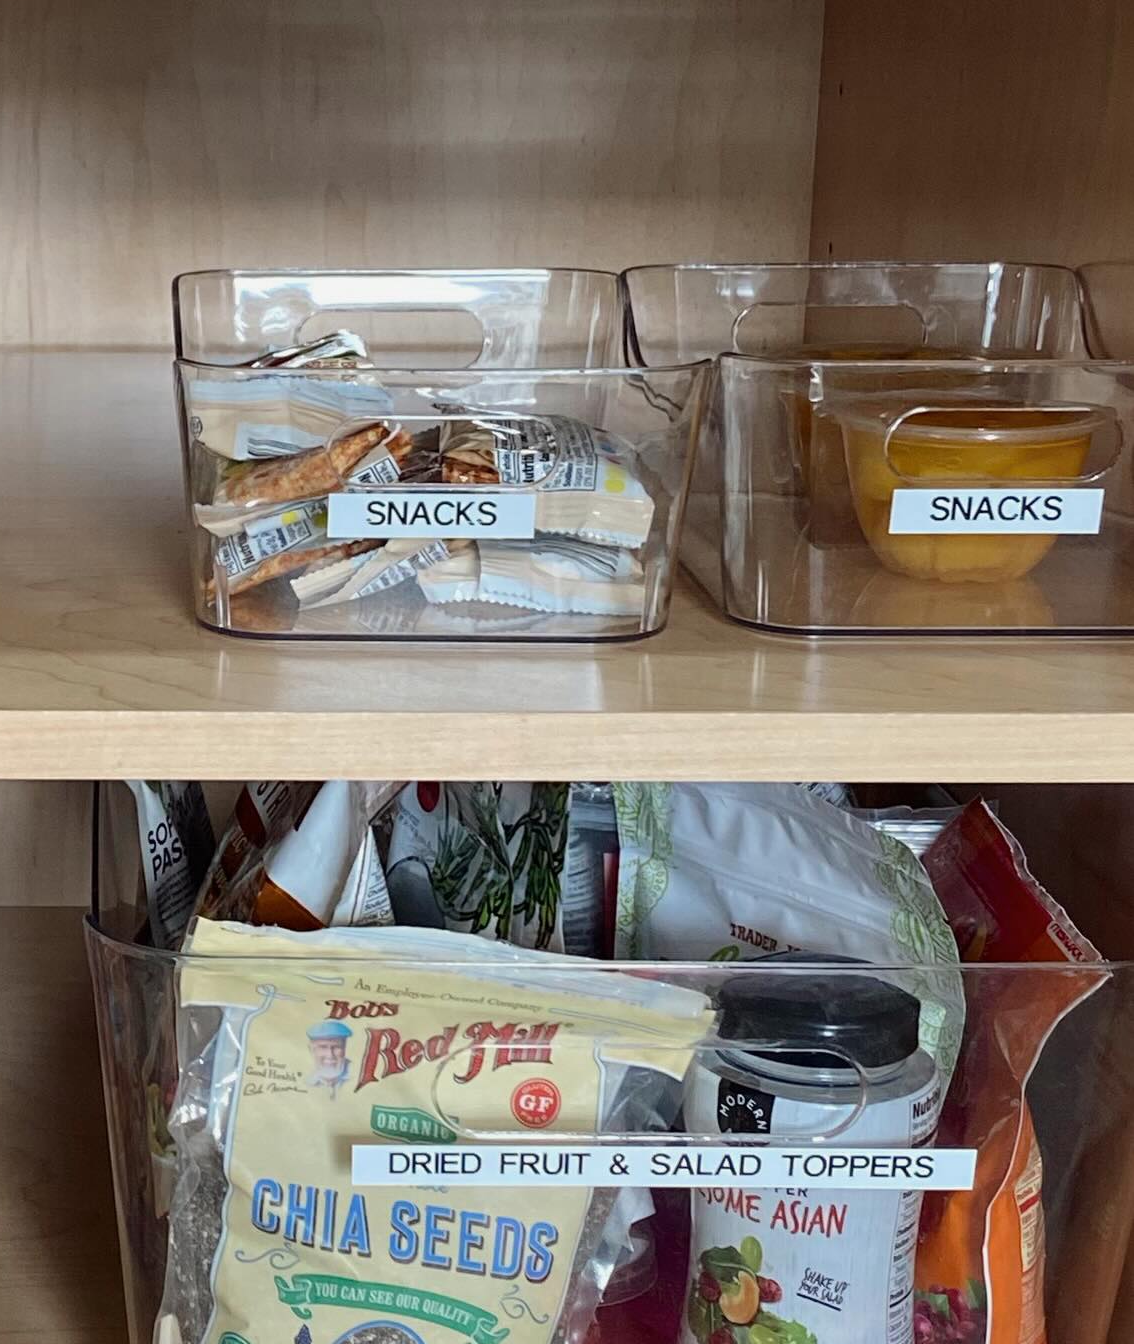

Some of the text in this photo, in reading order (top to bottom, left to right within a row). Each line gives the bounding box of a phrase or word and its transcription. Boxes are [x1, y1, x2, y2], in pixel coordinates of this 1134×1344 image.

[367, 501, 497, 526] SNACKS
[930, 495, 1063, 521] SNACKS
[729, 922, 778, 952] TRADER
[353, 1021, 563, 1093] Red Mill
[519, 1095, 554, 1112] GF
[719, 1094, 767, 1130] MODERN
[389, 1153, 934, 1179] DRIED FRUIT & SALAD TOPPERS
[252, 1179, 558, 1283] CHIA SEEDS
[770, 1200, 847, 1238] ASIAN
[799, 1280, 844, 1306] YOUR SALAD
[804, 1267, 849, 1293] SHAKE UP
[315, 1280, 474, 1325] YOU CAN SEE OUR QUALITY
